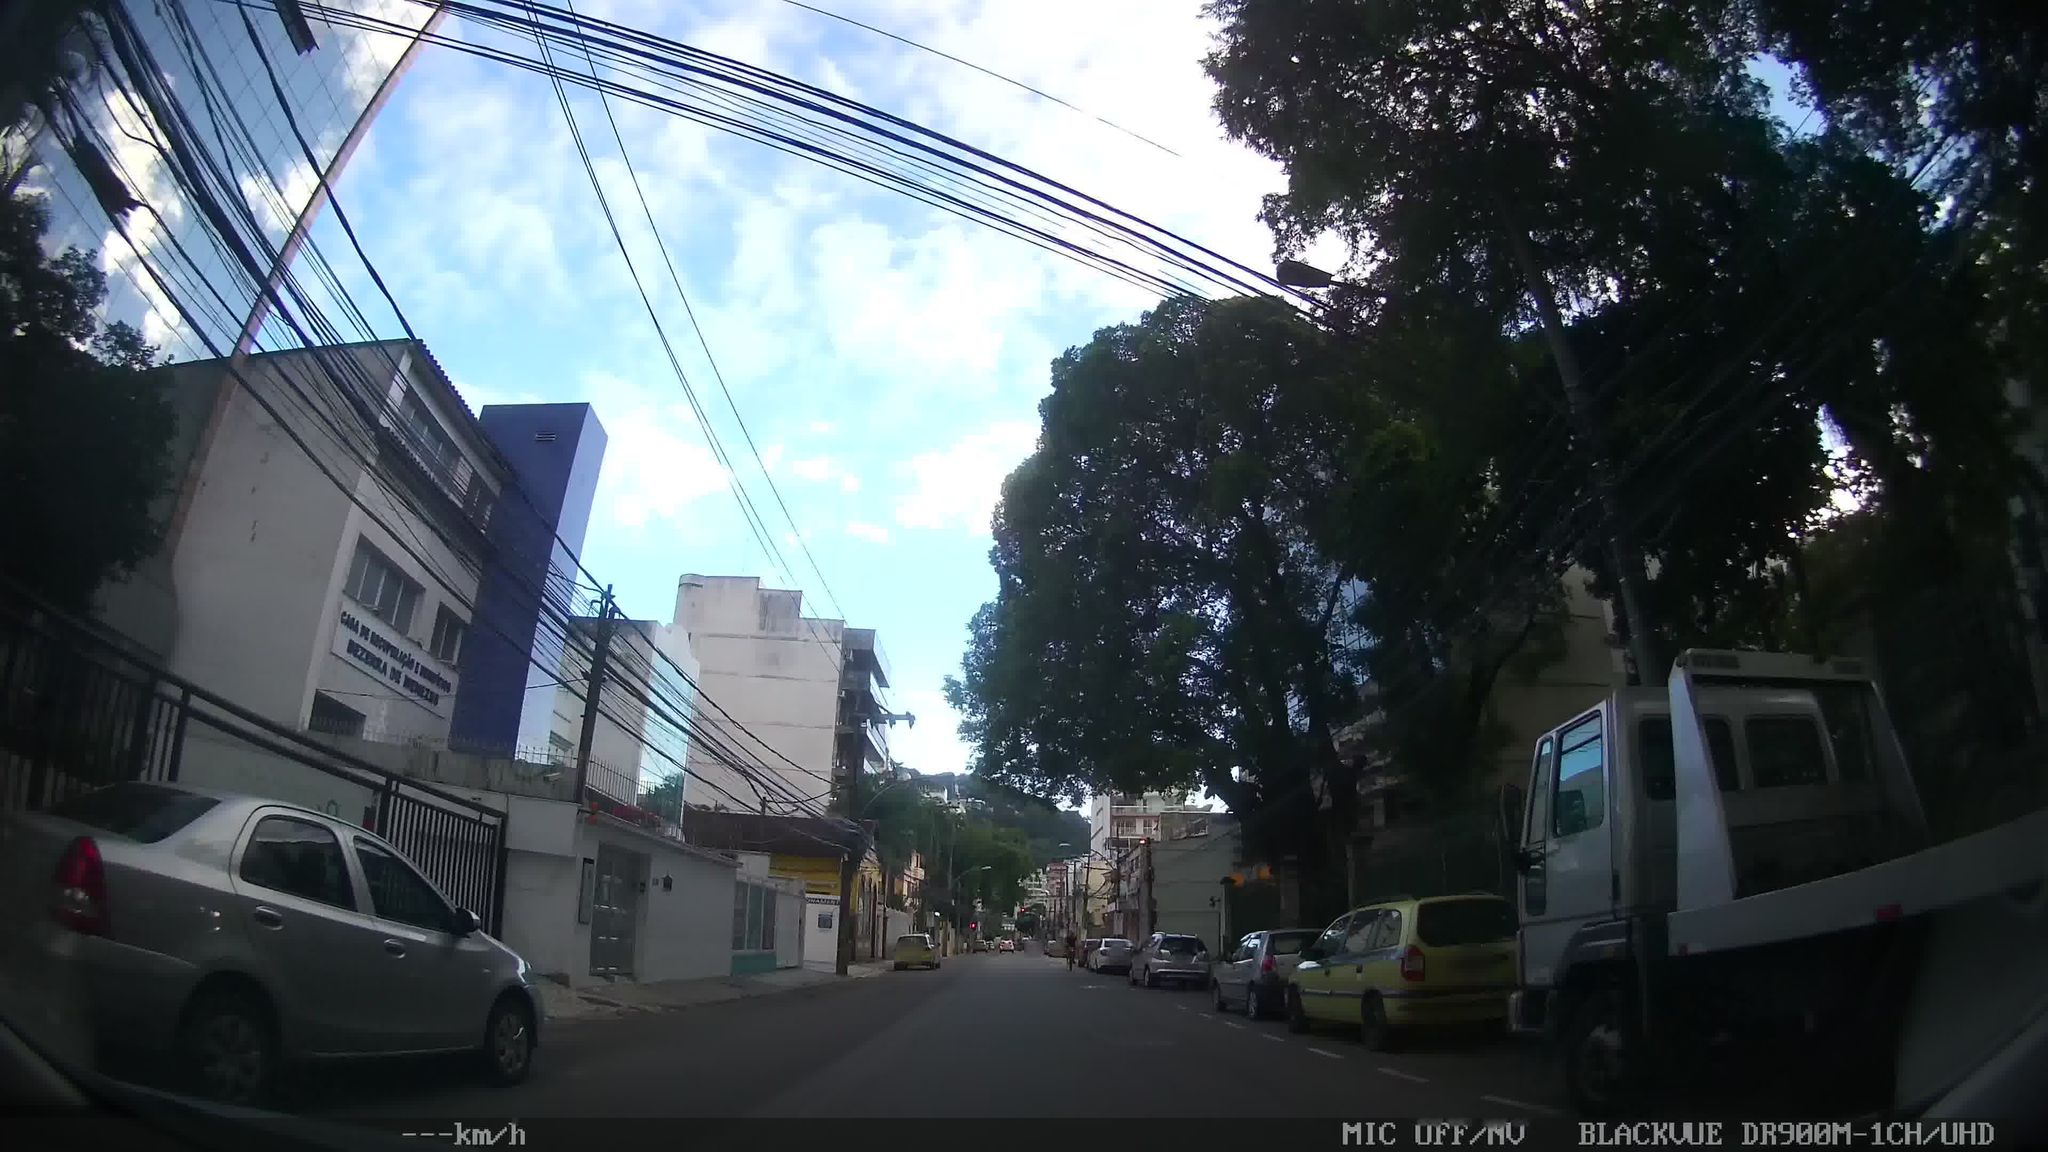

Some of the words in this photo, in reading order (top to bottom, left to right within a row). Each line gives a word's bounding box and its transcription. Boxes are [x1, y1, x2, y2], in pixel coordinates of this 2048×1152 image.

[341, 611, 359, 634] CASA
[360, 624, 370, 641] DE
[415, 662, 421, 675] E
[390, 666, 402, 684] DE
